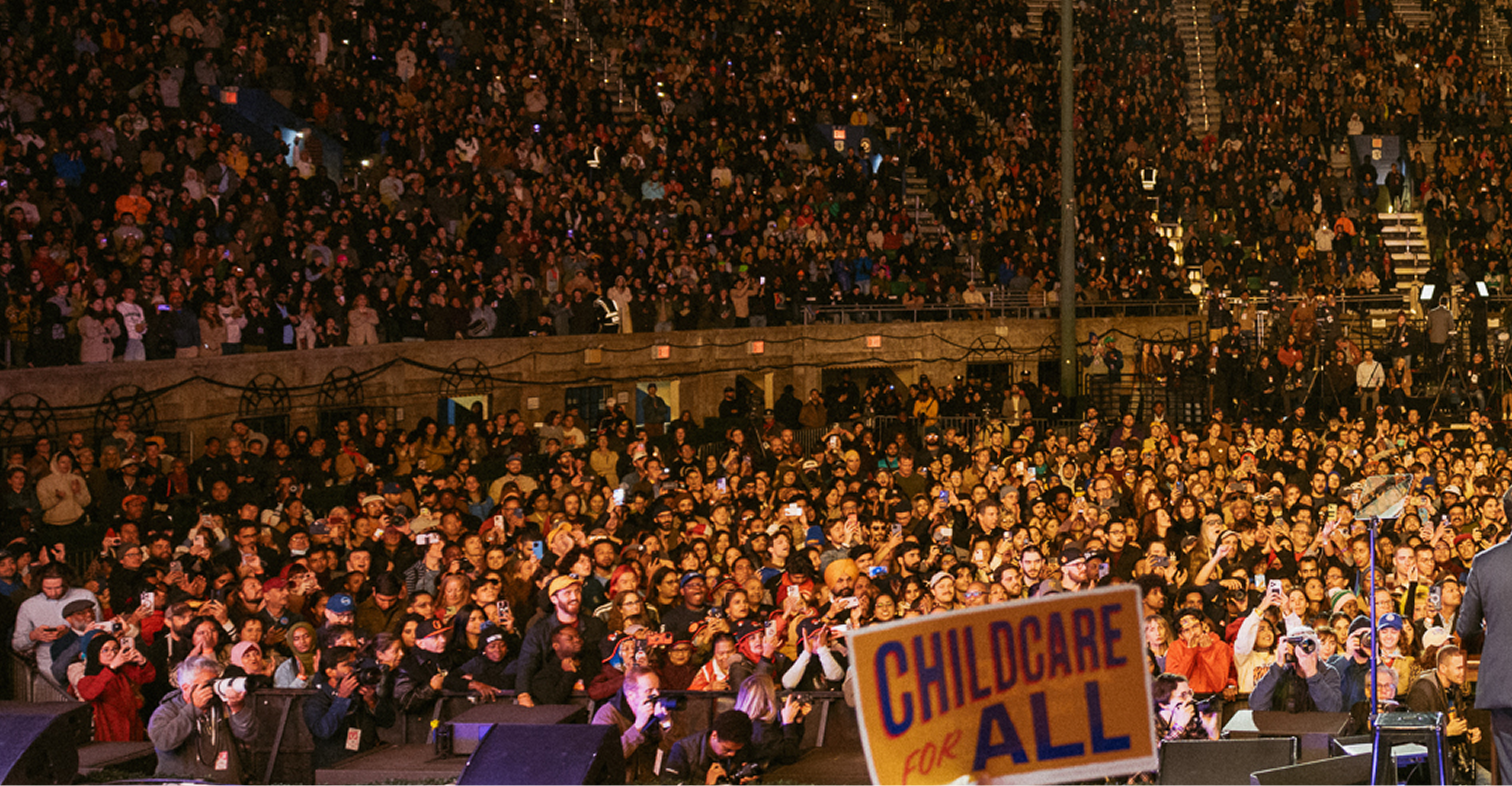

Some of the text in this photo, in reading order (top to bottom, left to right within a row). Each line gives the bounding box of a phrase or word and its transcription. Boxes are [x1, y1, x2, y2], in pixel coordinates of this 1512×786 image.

[874, 603, 1127, 739] CHILDCARE
[902, 730, 962, 786] FOR
[972, 681, 1130, 771] ALL
